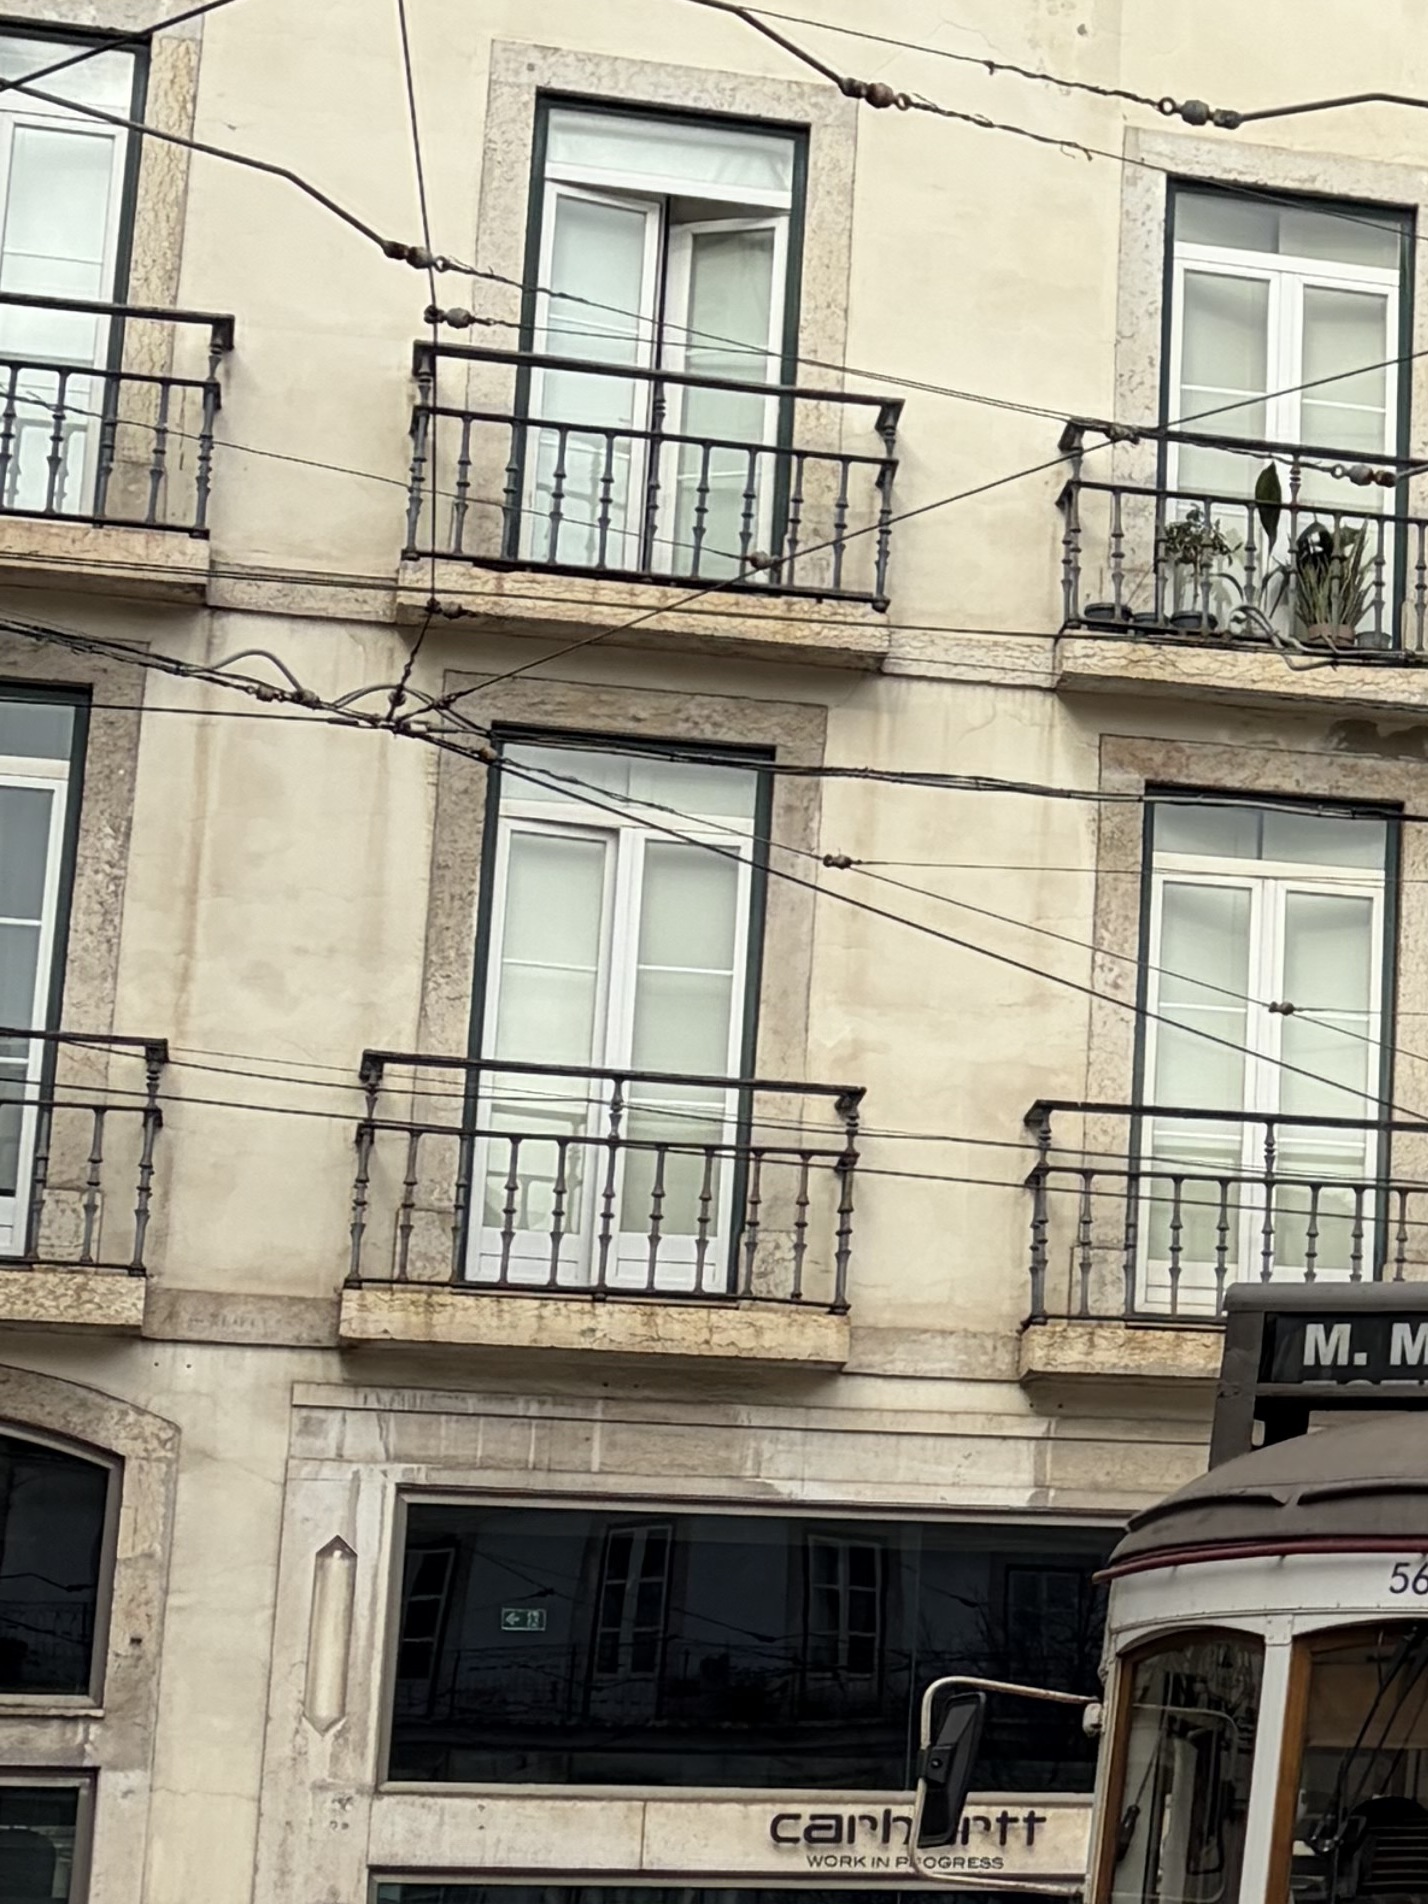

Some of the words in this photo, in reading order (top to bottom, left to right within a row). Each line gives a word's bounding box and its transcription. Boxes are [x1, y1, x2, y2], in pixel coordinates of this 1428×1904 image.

[1303, 1322, 1367, 1366] M.
[770, 1808, 1047, 1847] carhrtt
[806, 1855, 866, 1869] WORK
[871, 1856, 890, 1869] IN
[895, 1856, 1005, 1870] POGRESS
